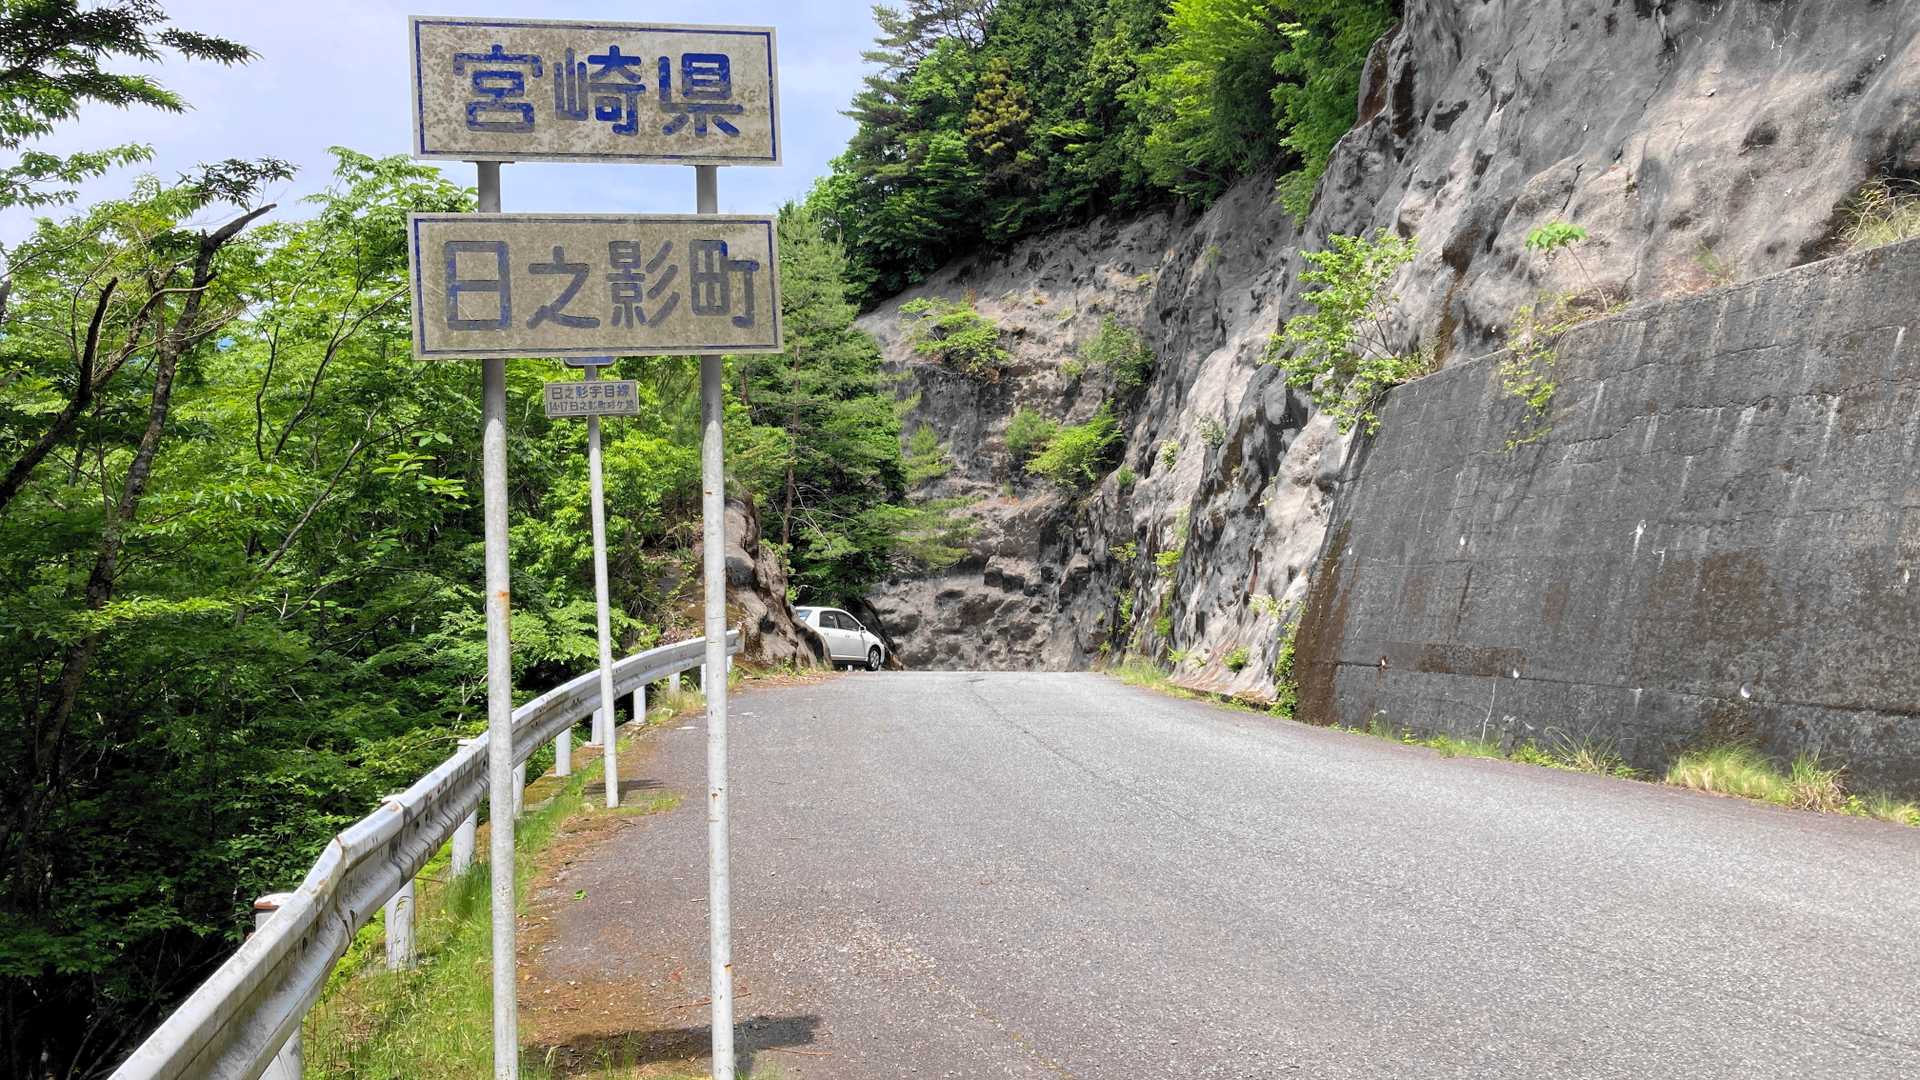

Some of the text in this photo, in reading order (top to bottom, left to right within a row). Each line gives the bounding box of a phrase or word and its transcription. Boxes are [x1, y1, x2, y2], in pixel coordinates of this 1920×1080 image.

[454, 44, 744, 137] 宮崎県
[443, 239, 760, 330] 日之影町
[551, 384, 630, 400] 日之影宇目線
